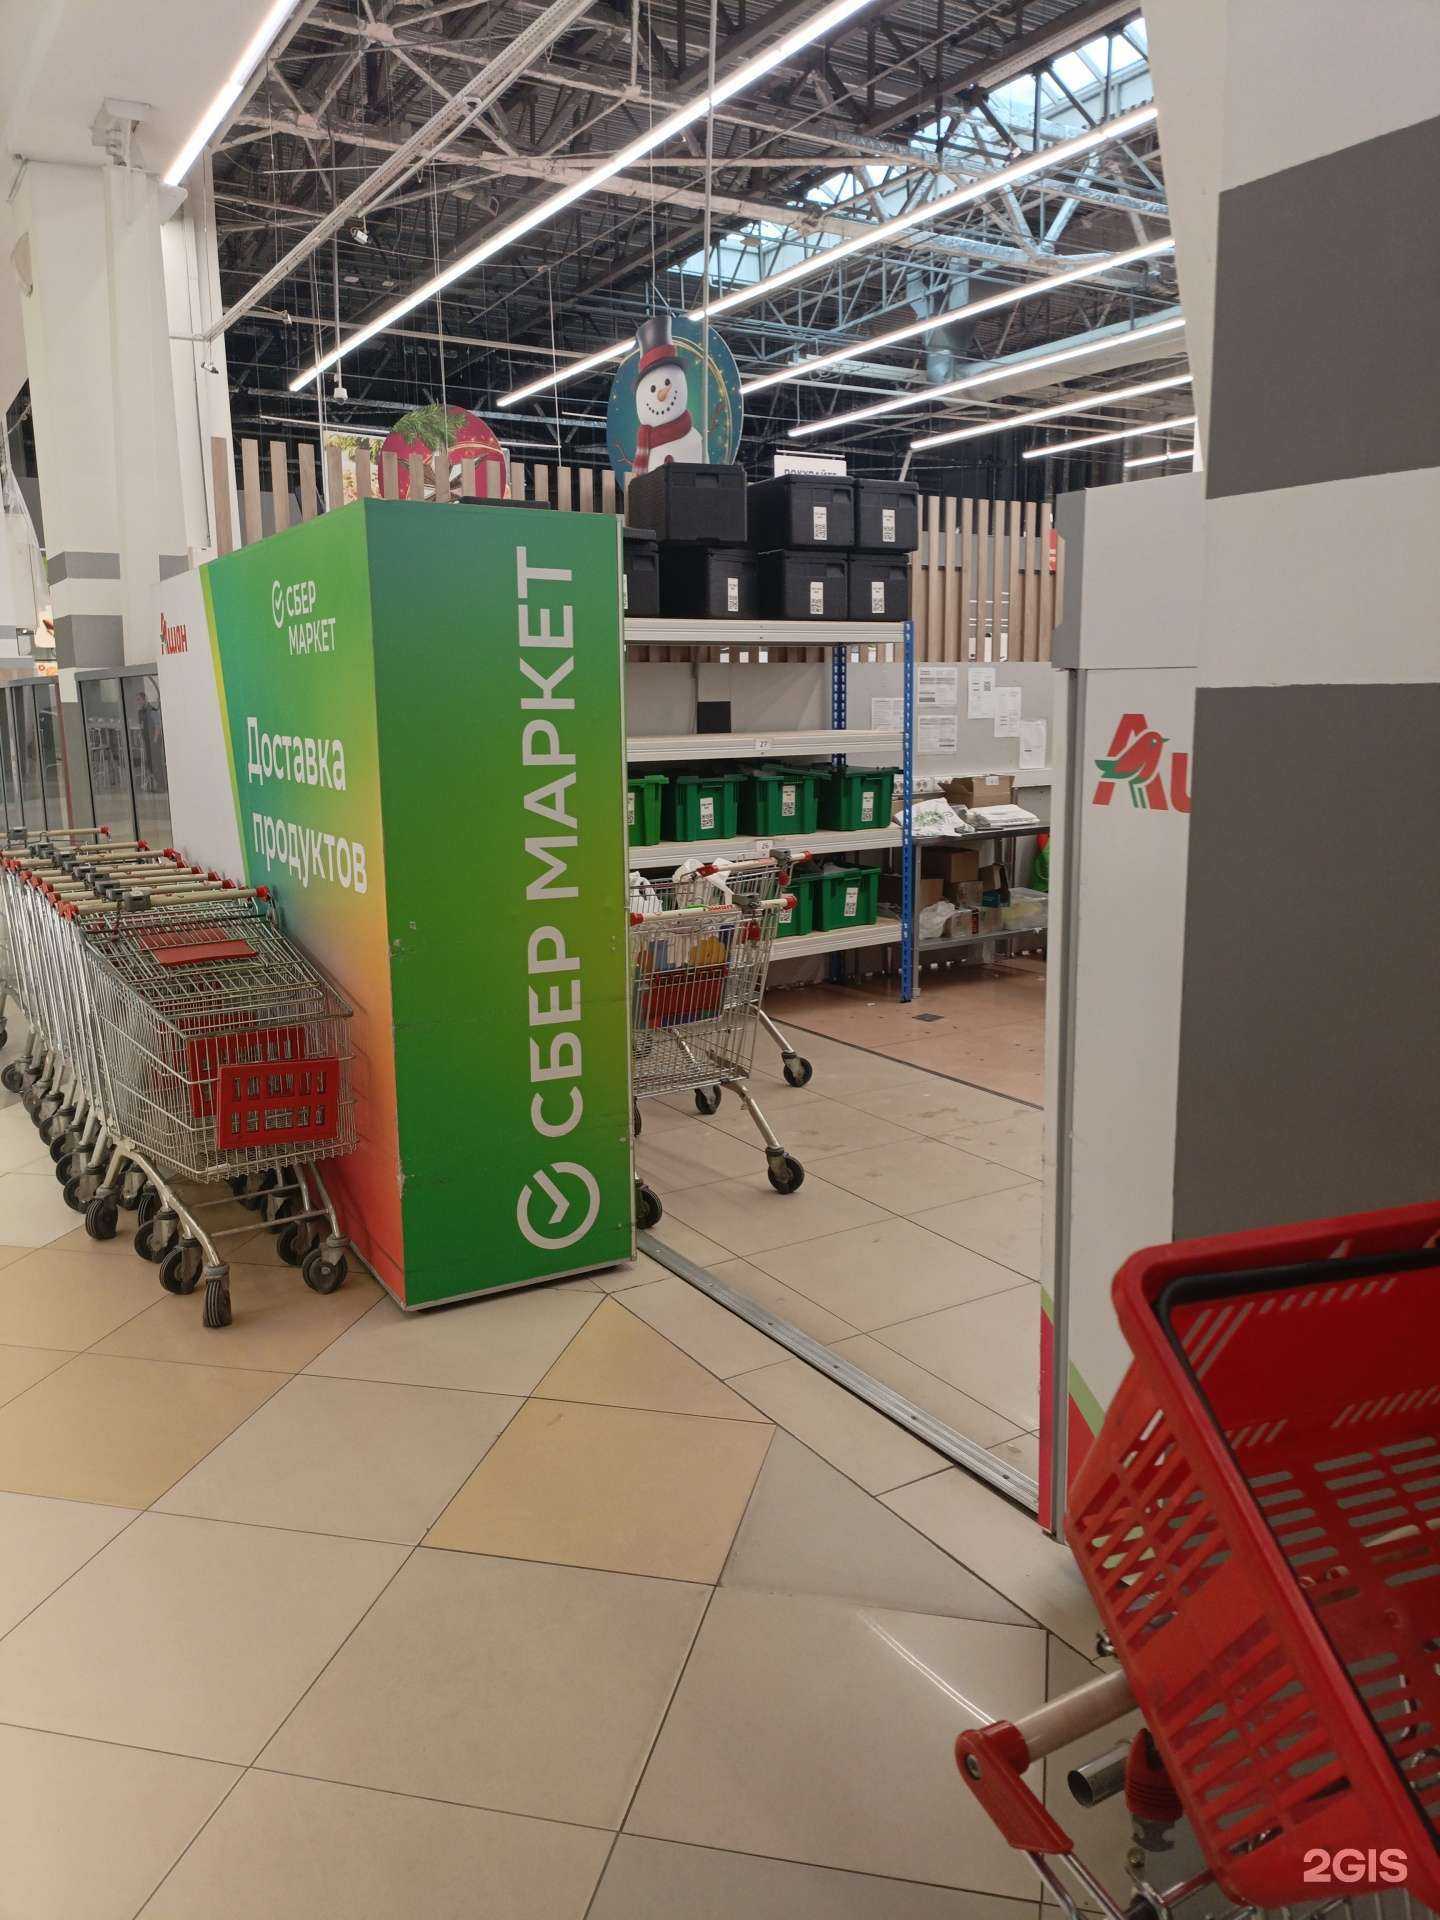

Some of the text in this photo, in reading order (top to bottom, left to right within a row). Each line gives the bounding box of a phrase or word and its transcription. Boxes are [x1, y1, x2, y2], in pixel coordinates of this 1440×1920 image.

[286, 580, 316, 617] СБЕР
[288, 617, 336, 656] МАРКЕТ
[247, 716, 347, 791] Доставка
[252, 811, 368, 895] продуктов
[515, 545, 583, 1137] СБЕР МАРКЕТ
